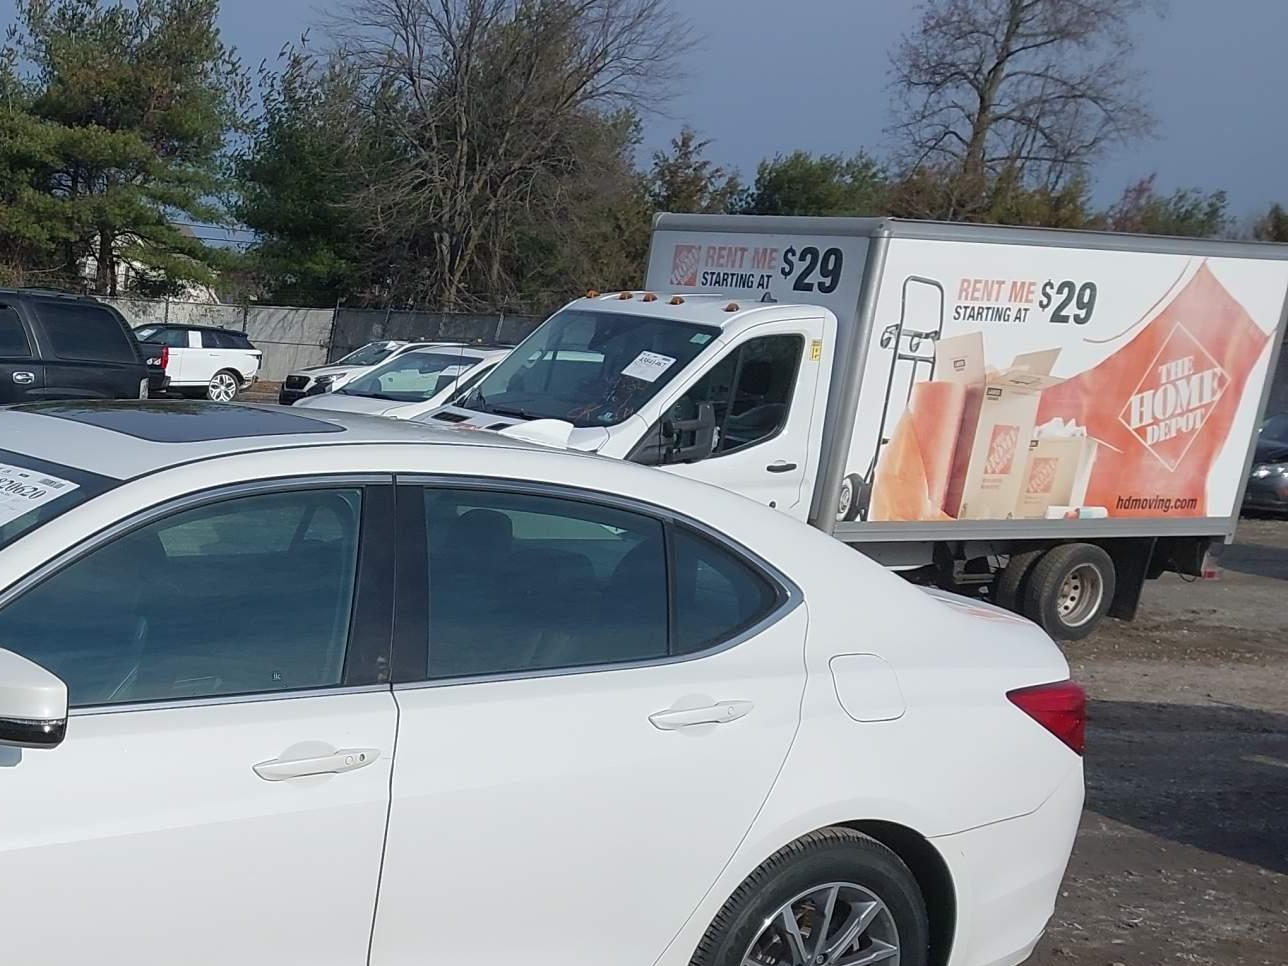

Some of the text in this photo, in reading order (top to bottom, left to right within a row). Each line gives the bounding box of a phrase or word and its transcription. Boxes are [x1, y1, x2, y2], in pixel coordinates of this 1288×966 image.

[705, 245, 779, 270] RENT ME
[780, 245, 844, 294] $29
[701, 271, 773, 290] STARTING AT
[958, 278, 1036, 304] RENT ME
[953, 305, 1030, 323] STARTING AT
[1038, 279, 1097, 325] $29
[1158, 355, 1194, 384] THE
[1129, 367, 1224, 430] HOME
[1146, 408, 1205, 446] DEPOT
[1116, 495, 1198, 512] hdmoving.com
